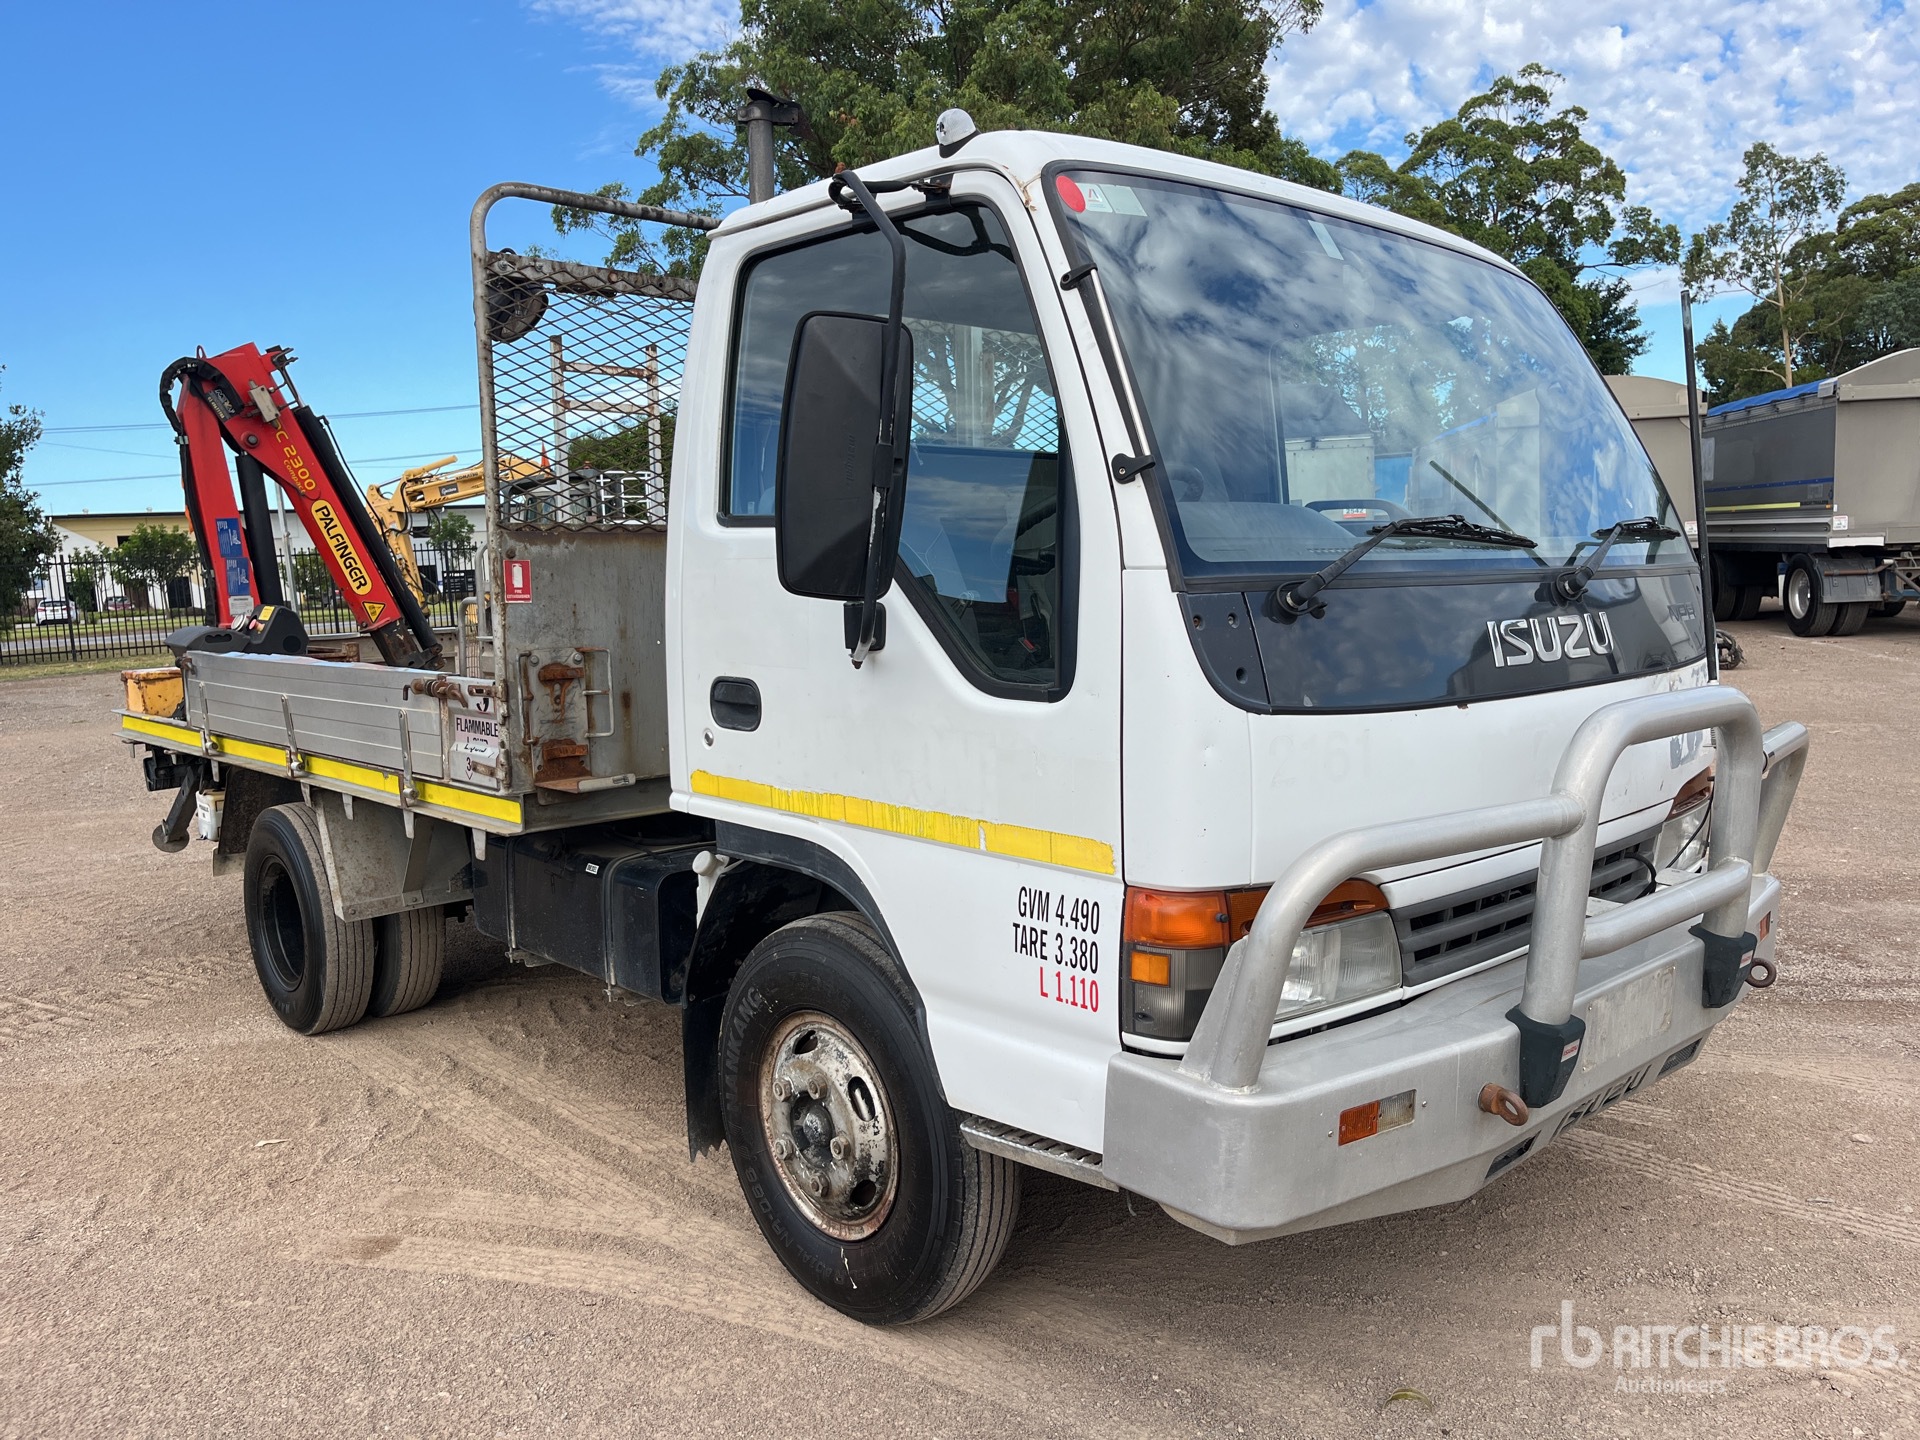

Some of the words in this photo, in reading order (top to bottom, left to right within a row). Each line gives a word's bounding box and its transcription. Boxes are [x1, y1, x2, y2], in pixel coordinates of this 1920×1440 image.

[283, 444, 316, 491] 2300
[315, 505, 368, 590] PALFINGER
[1486, 611, 1614, 668] ISUZU
[456, 717, 499, 738] FLAMMABLE
[466, 756, 472, 772] 3
[1018, 886, 1050, 923] GVM
[1055, 894, 1100, 935] 4.490
[1012, 922, 1048, 961] TARE
[1055, 932, 1099, 975] 3.380
[1040, 966, 1049, 998] L
[1055, 971, 1099, 1013] 1.110
[725, 985, 762, 1111] NANKANG
